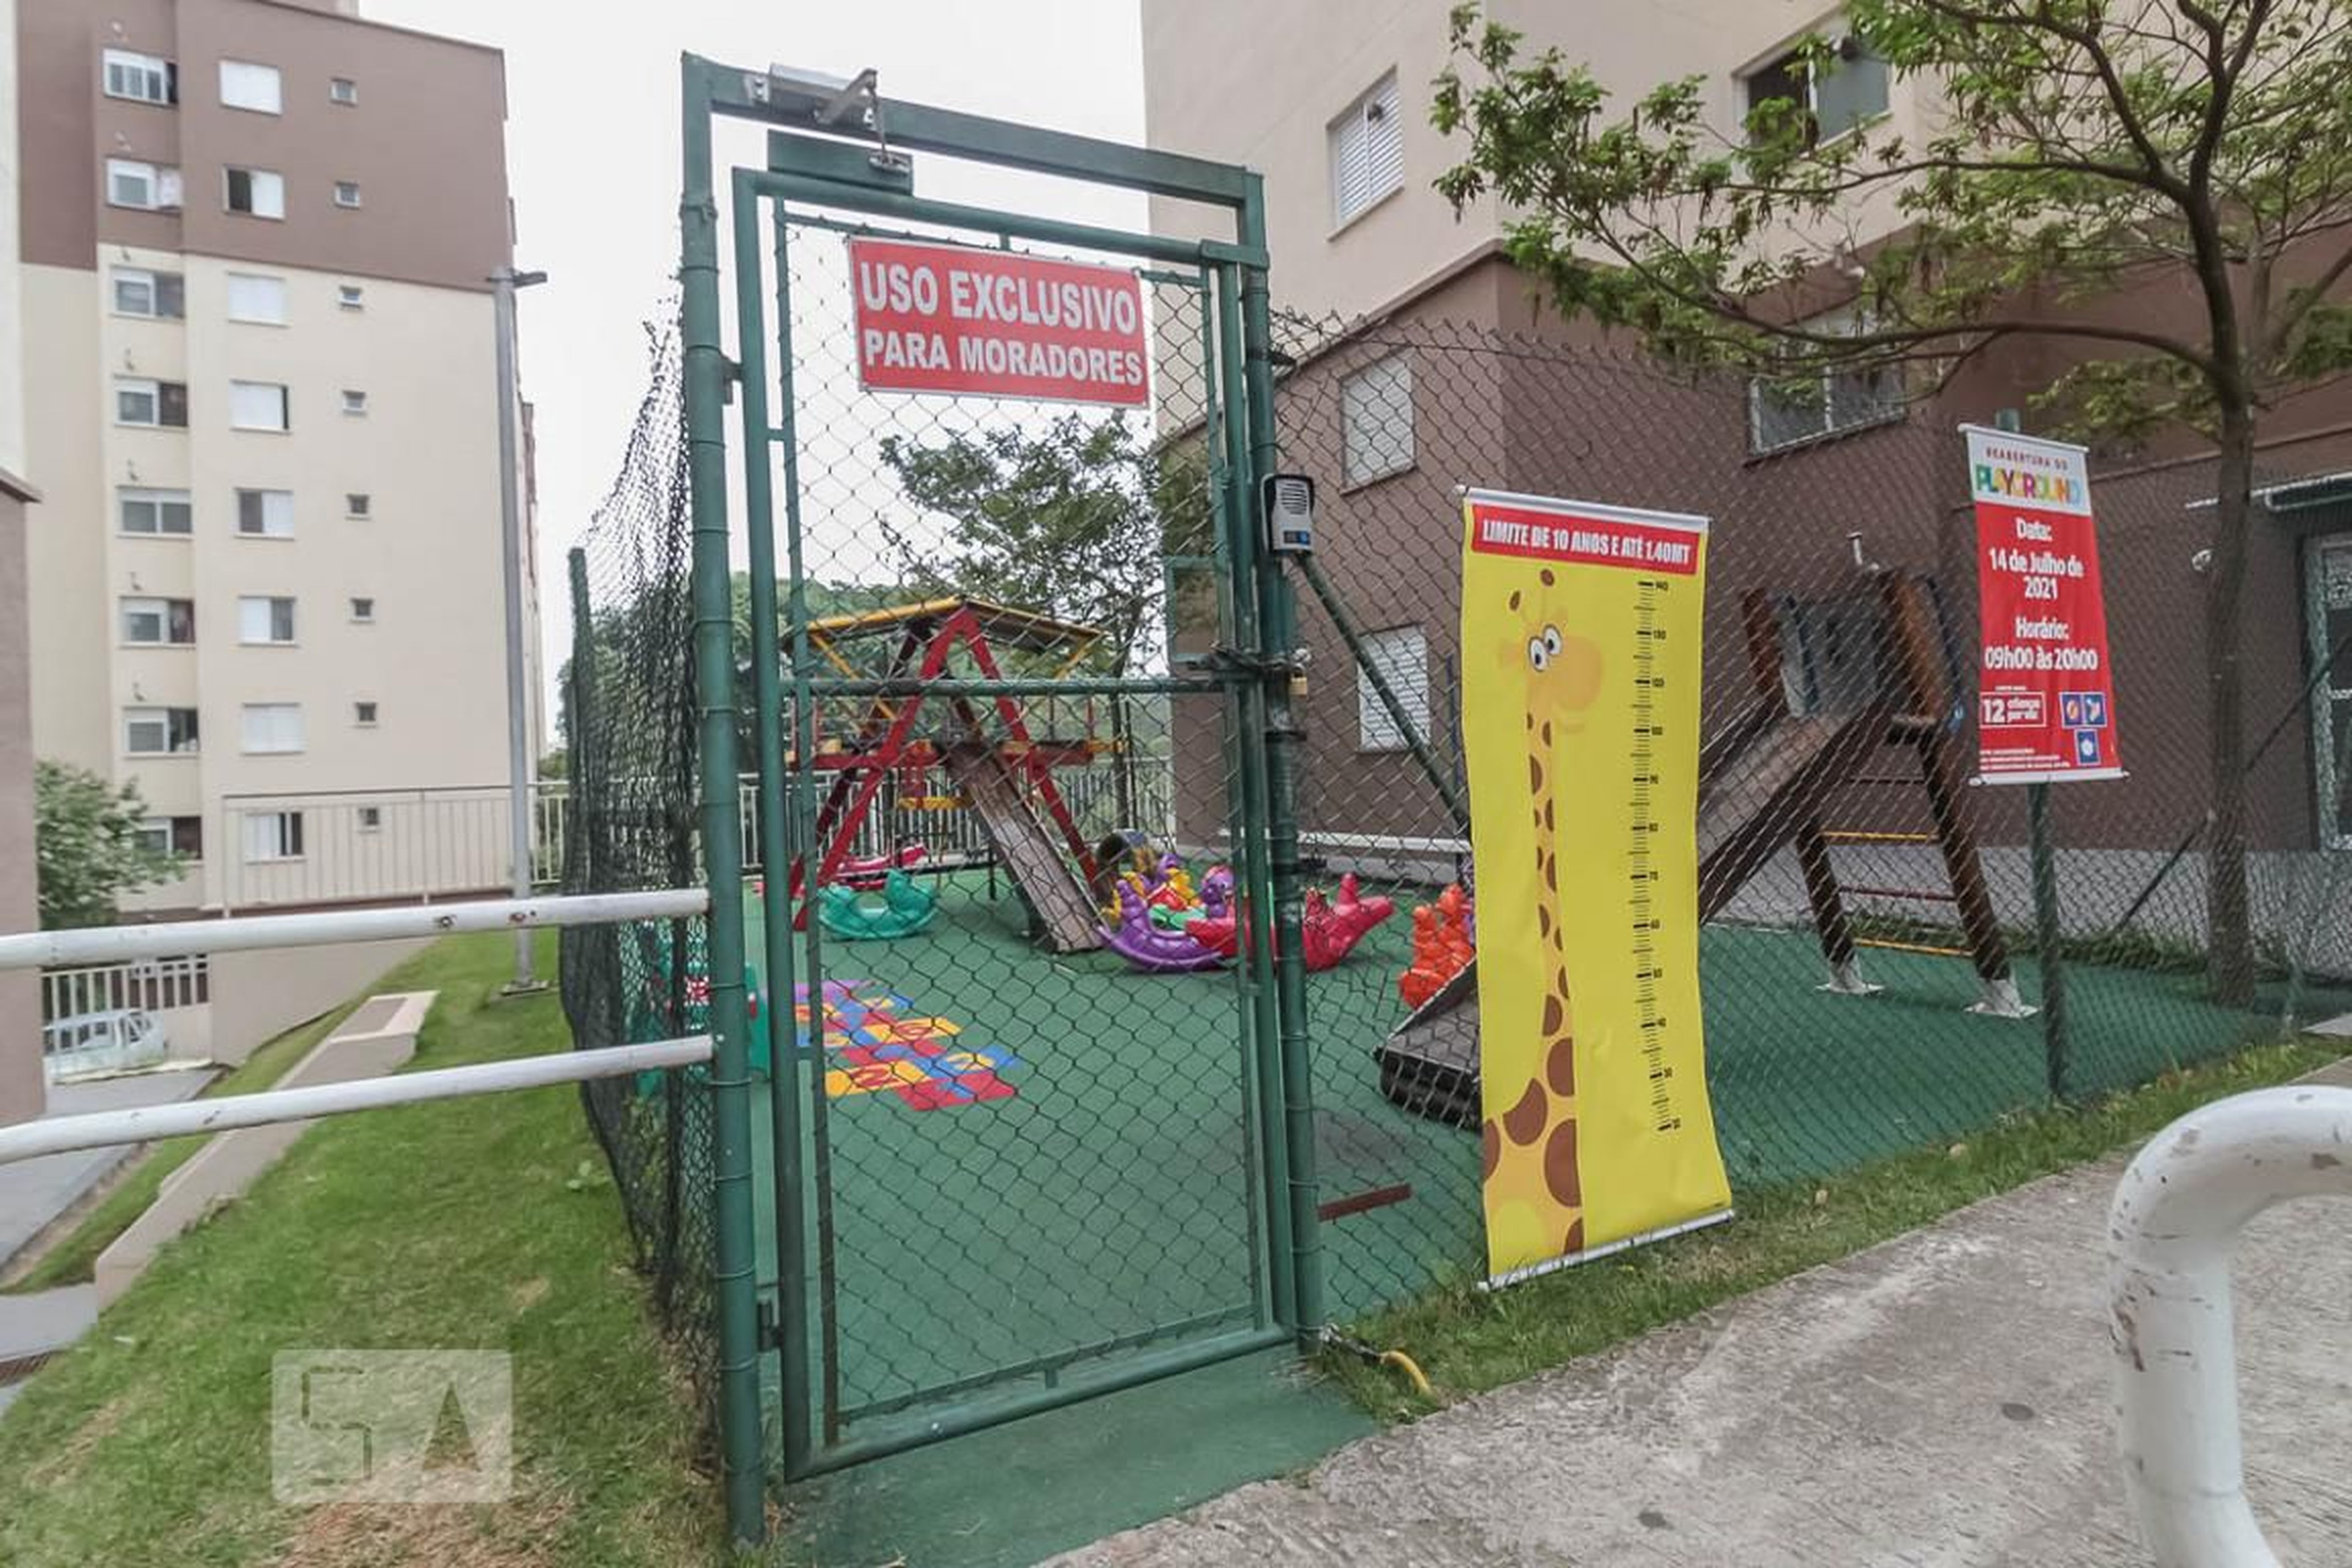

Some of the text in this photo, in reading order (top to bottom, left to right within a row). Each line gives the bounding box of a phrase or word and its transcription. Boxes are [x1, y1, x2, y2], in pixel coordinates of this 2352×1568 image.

[860, 262, 1136, 334] USO EXCLUSIVO
[864, 329, 1144, 386] PARA MORADORES
[1977, 466, 2081, 503] PLAYGROUND
[1482, 518, 1692, 565] LIMITE DE 10 ANOS E ATÉ 1.40MT
[2016, 518, 2052, 541] Data:
[1989, 547, 2084, 578] 14 de Julho de
[2023, 575, 2059, 600] 2021
[2016, 617, 2069, 639] Horário:
[1985, 644, 2097, 670] 09h00 às 20h00
[1983, 699, 2005, 723] 12
